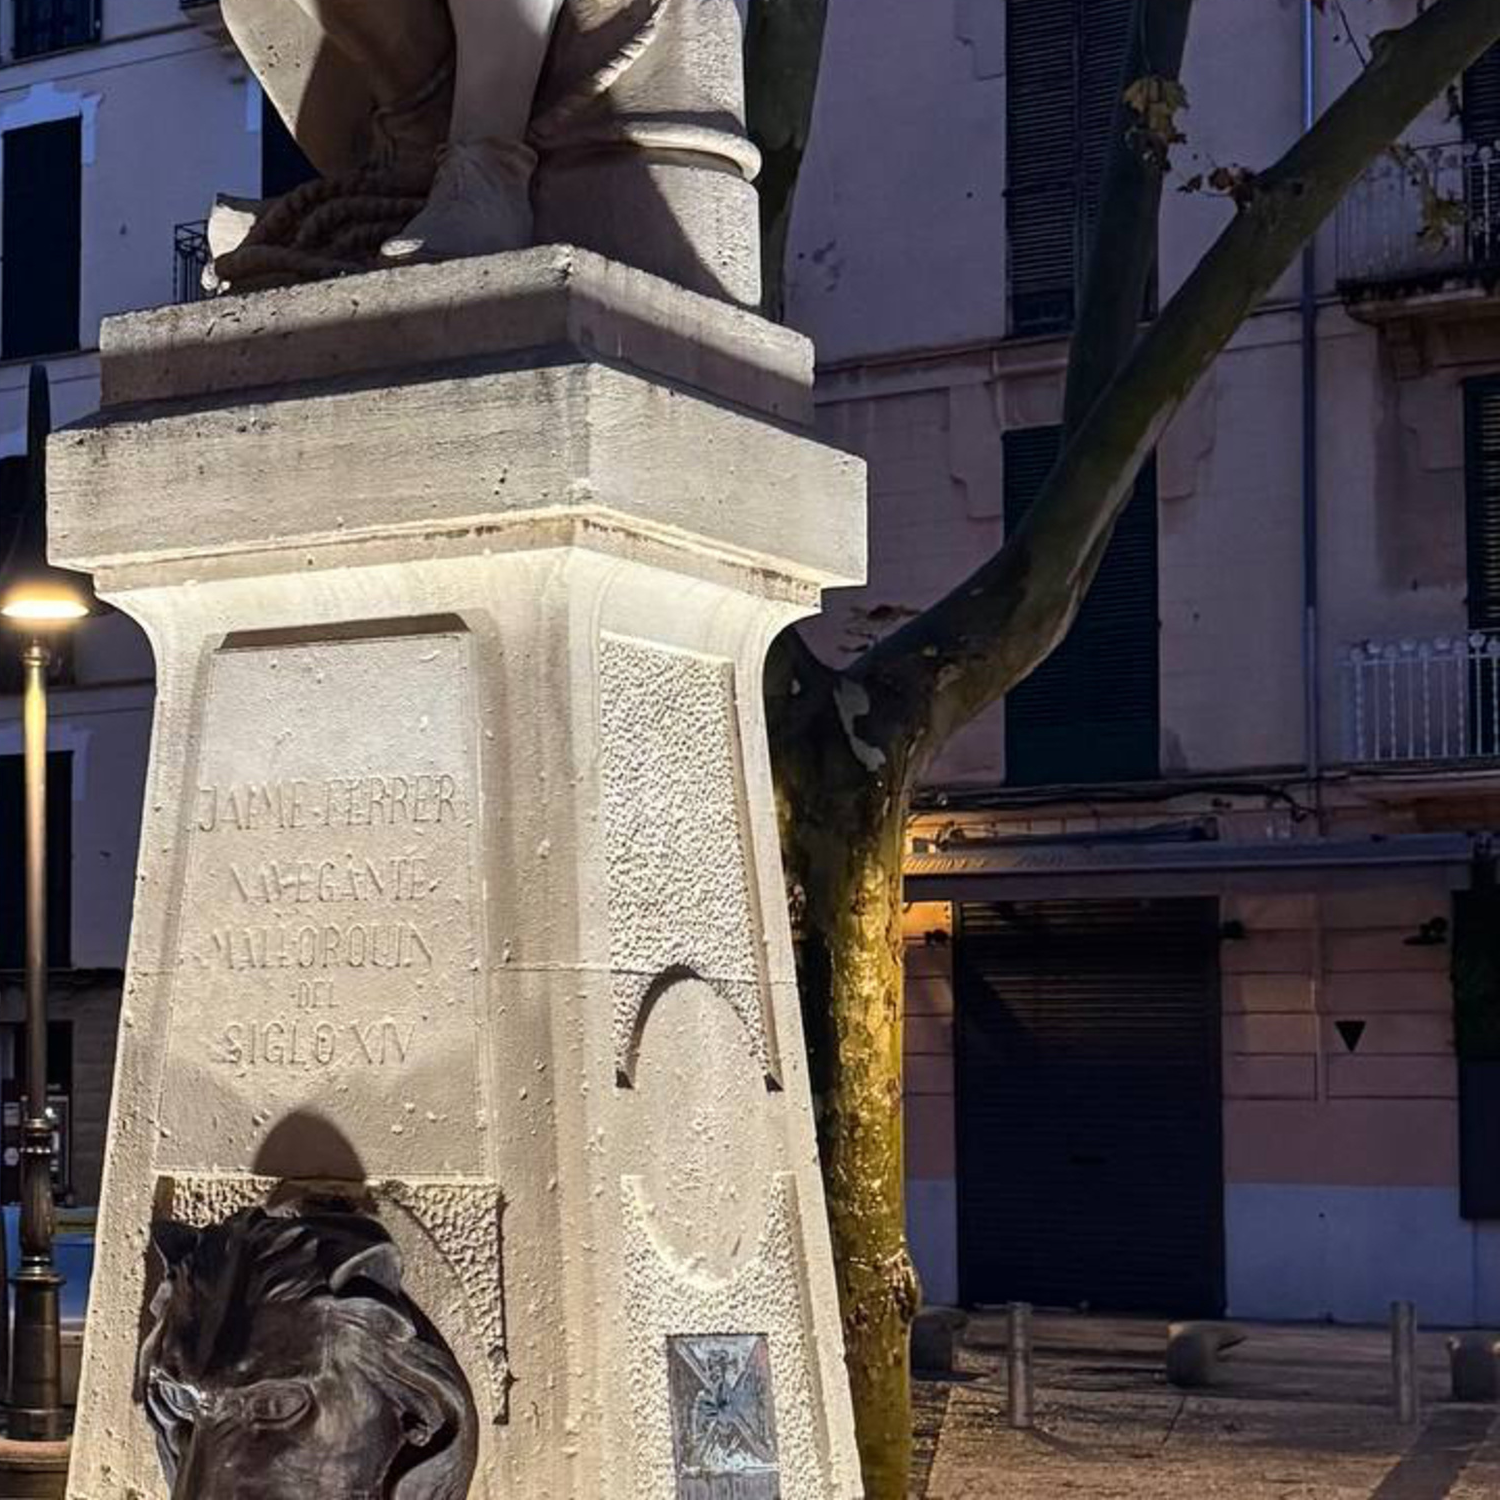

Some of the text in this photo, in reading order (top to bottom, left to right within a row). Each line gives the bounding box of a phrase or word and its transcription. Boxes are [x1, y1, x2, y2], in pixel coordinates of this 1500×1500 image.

[198, 773, 459, 834] JAIME FERRER
[297, 979, 339, 1011] DEL
[219, 1017, 417, 1067] SIGLO XIV
